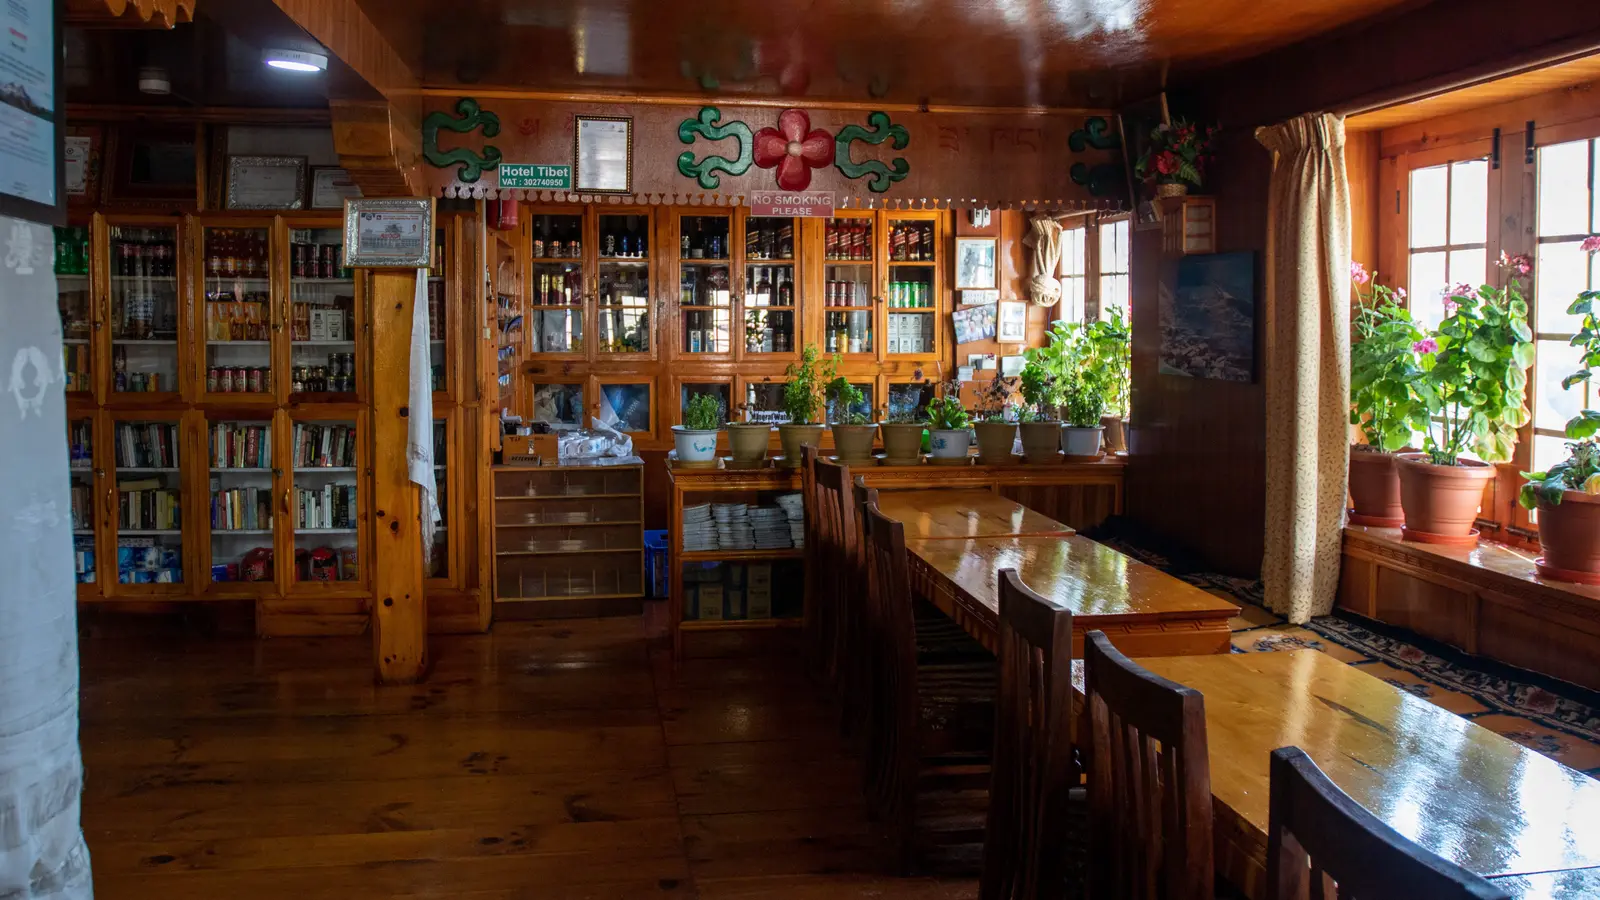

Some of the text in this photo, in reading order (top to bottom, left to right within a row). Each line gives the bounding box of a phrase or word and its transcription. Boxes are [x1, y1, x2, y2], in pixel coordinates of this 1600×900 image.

[501, 166, 569, 177] Hotel Tibet
[502, 178, 517, 186] VAT
[523, 178, 563, 187] 302740950
[753, 195, 831, 206] NO SMOKING
[772, 207, 813, 215] PLEASE
